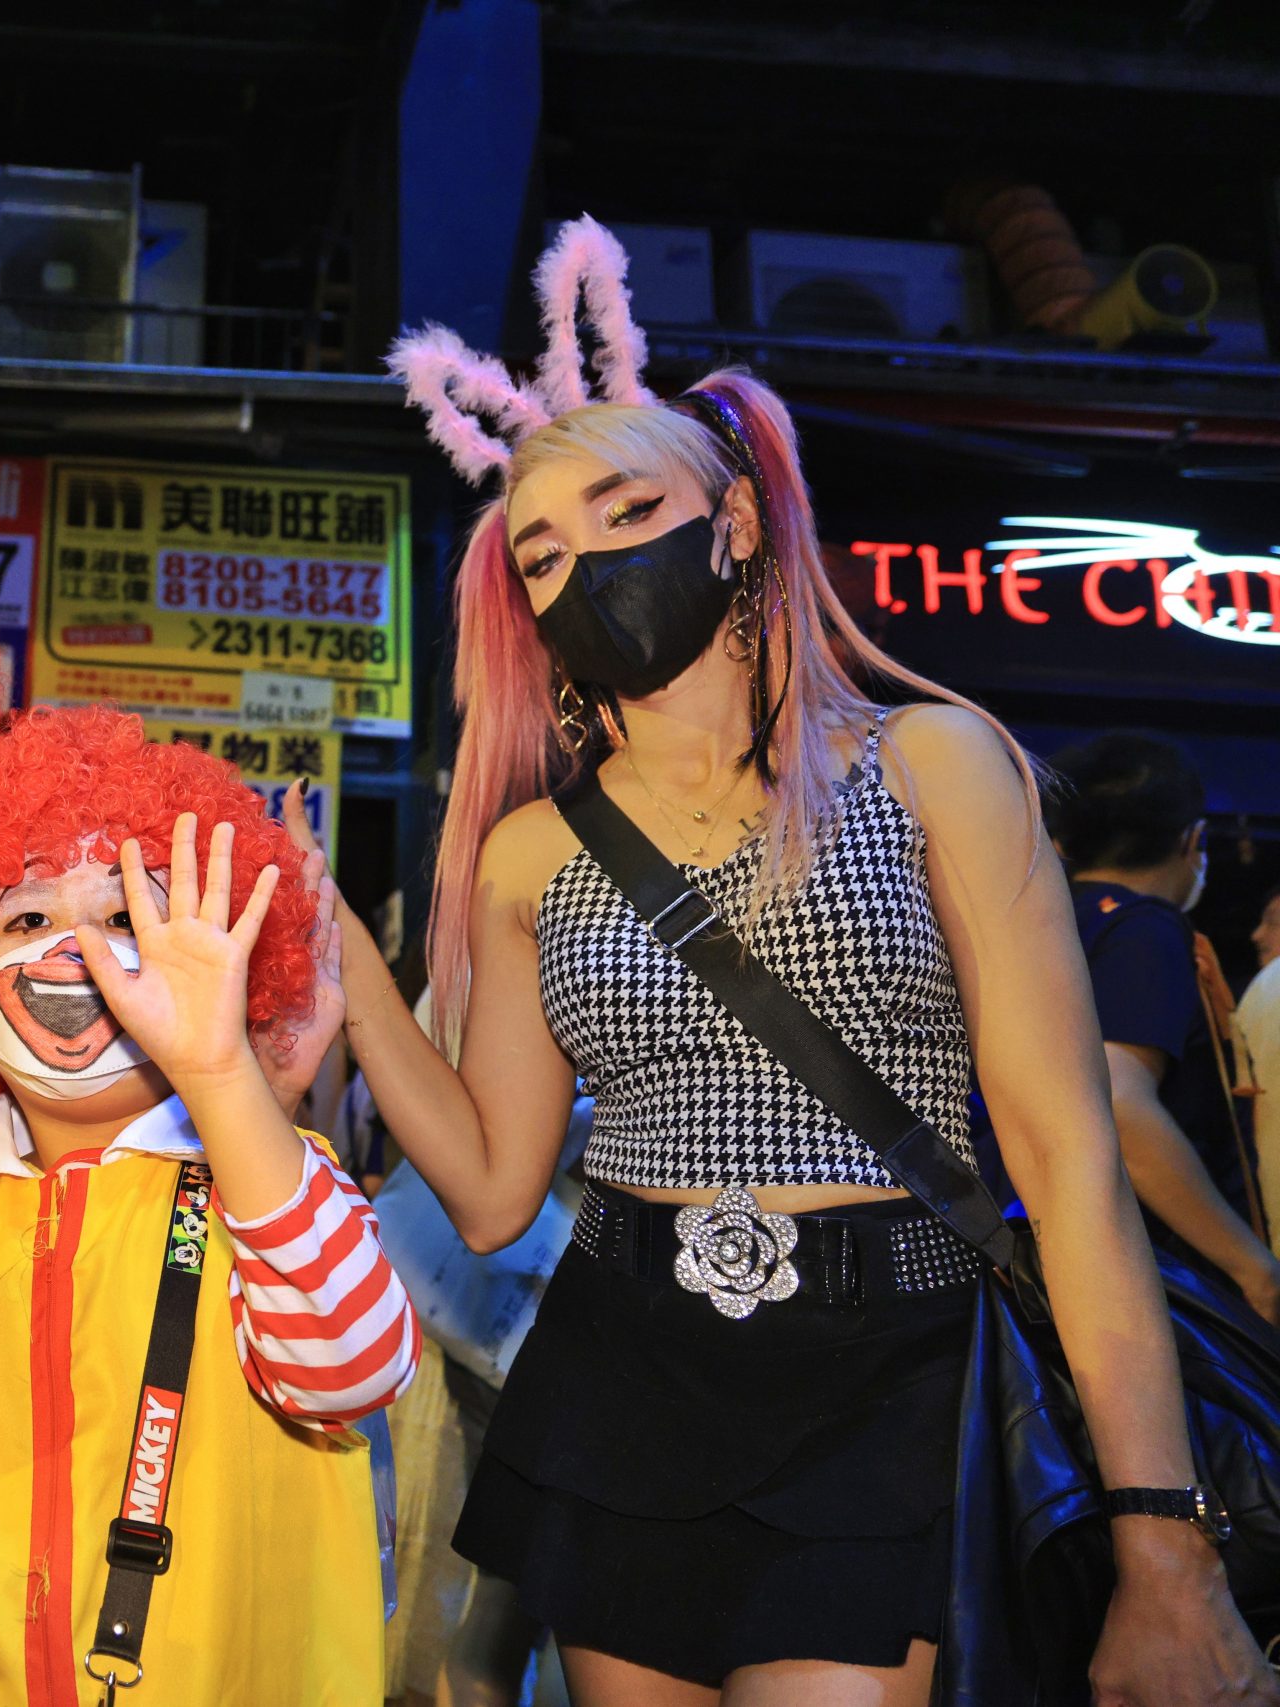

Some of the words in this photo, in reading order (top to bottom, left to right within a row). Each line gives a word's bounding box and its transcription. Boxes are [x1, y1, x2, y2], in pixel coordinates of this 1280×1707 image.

[162, 551, 383, 590] 8200-1877
[850, 540, 1051, 625] THE
[161, 578, 383, 620] 8105-5645
[211, 619, 389, 665] 2311-7368
[128, 1394, 176, 1524] MICKEY
